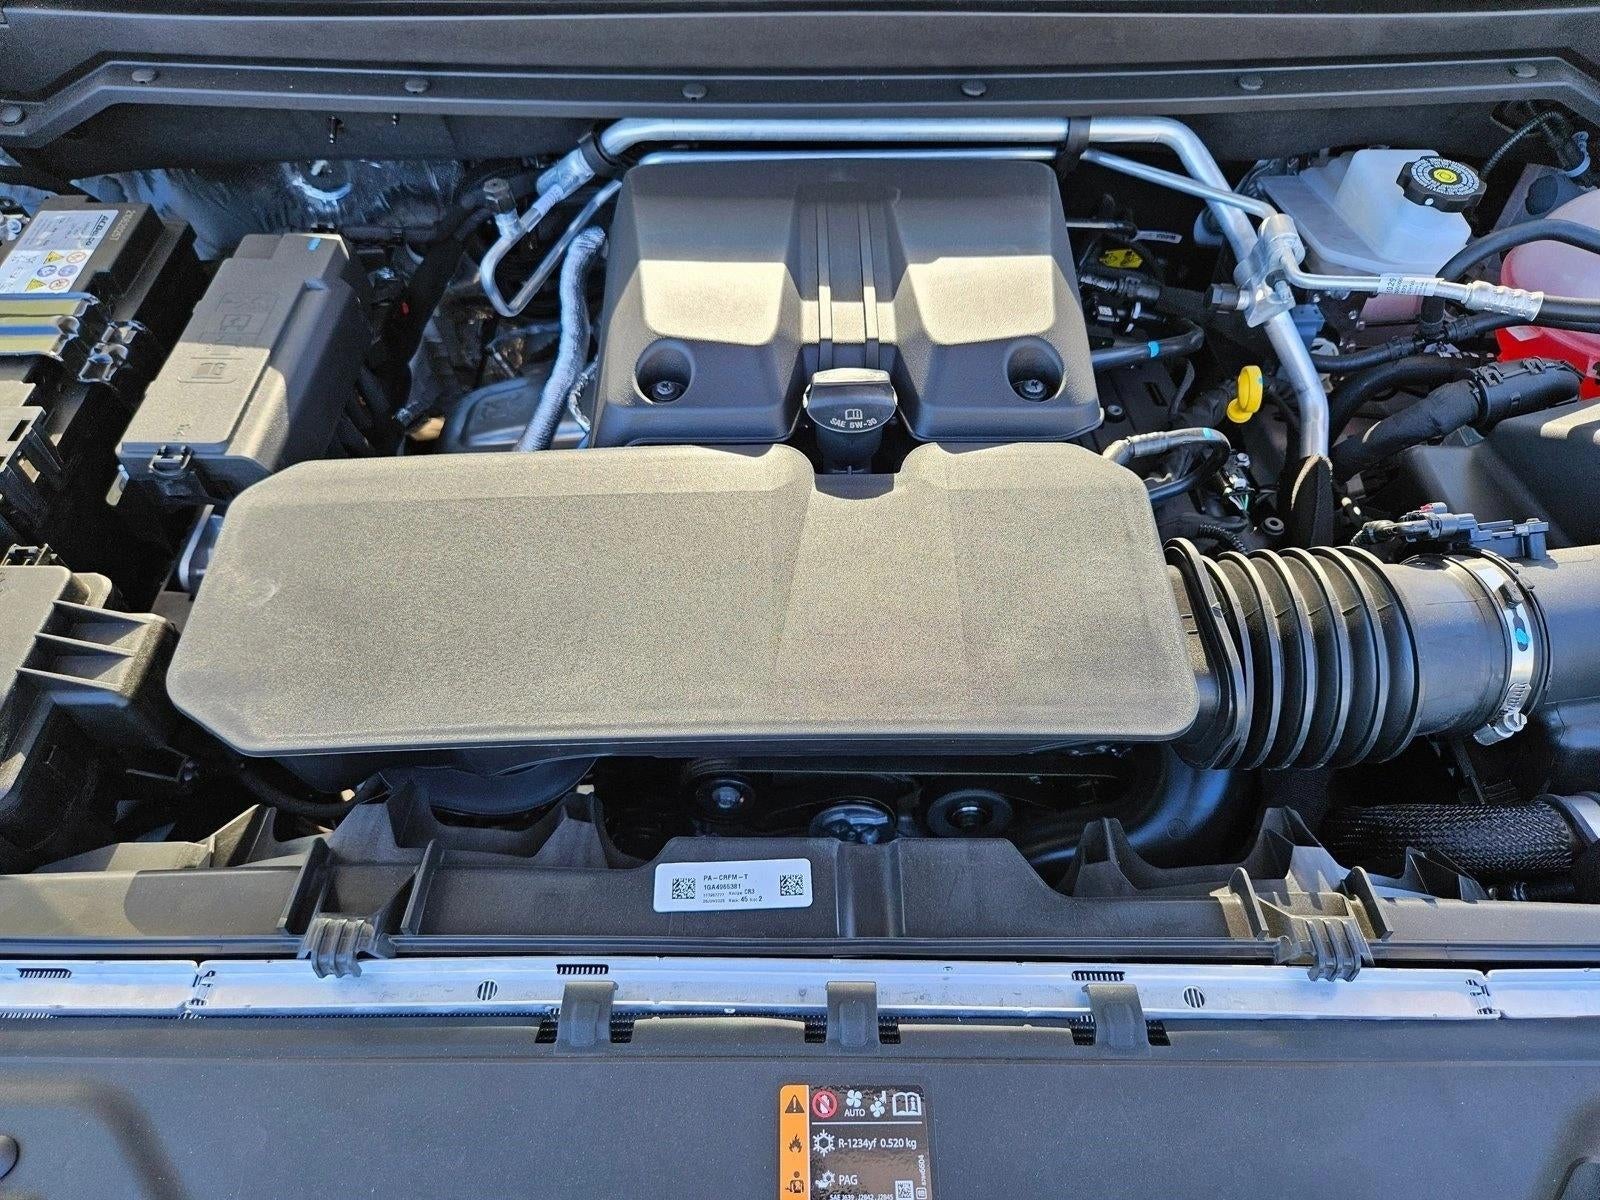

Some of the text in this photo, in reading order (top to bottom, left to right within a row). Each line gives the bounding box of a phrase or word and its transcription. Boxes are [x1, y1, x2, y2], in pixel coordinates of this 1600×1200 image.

[830, 417, 878, 429] SAE 5W-30
[844, 1108, 866, 1117] AUTO
[838, 1138, 917, 1150] R-1234yf 0.520 kg
[838, 1174, 858, 1185] PAG
